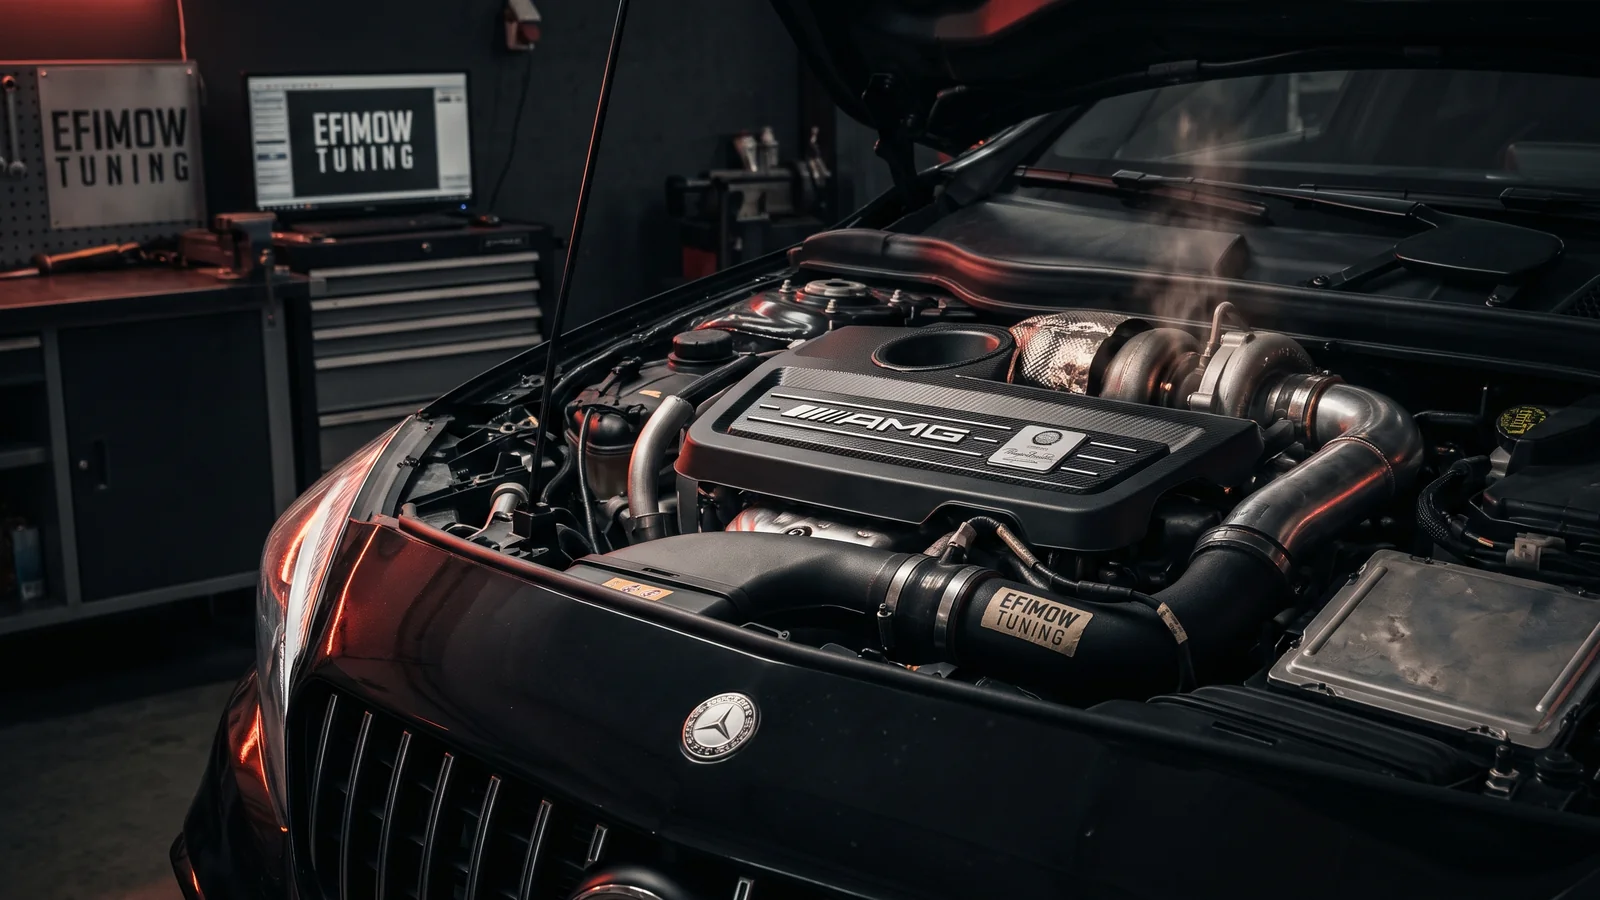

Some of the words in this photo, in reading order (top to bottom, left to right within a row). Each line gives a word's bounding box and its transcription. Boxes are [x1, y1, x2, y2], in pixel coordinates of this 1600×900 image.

[52, 107, 188, 152] EFIMOW
[312, 110, 413, 146] EFIMOW
[55, 152, 189, 188] TUNING
[315, 144, 414, 174] TUNING
[833, 412, 971, 443] AMG
[996, 610, 1065, 646] TUNING
[1000, 592, 1081, 629] EFIMOW
